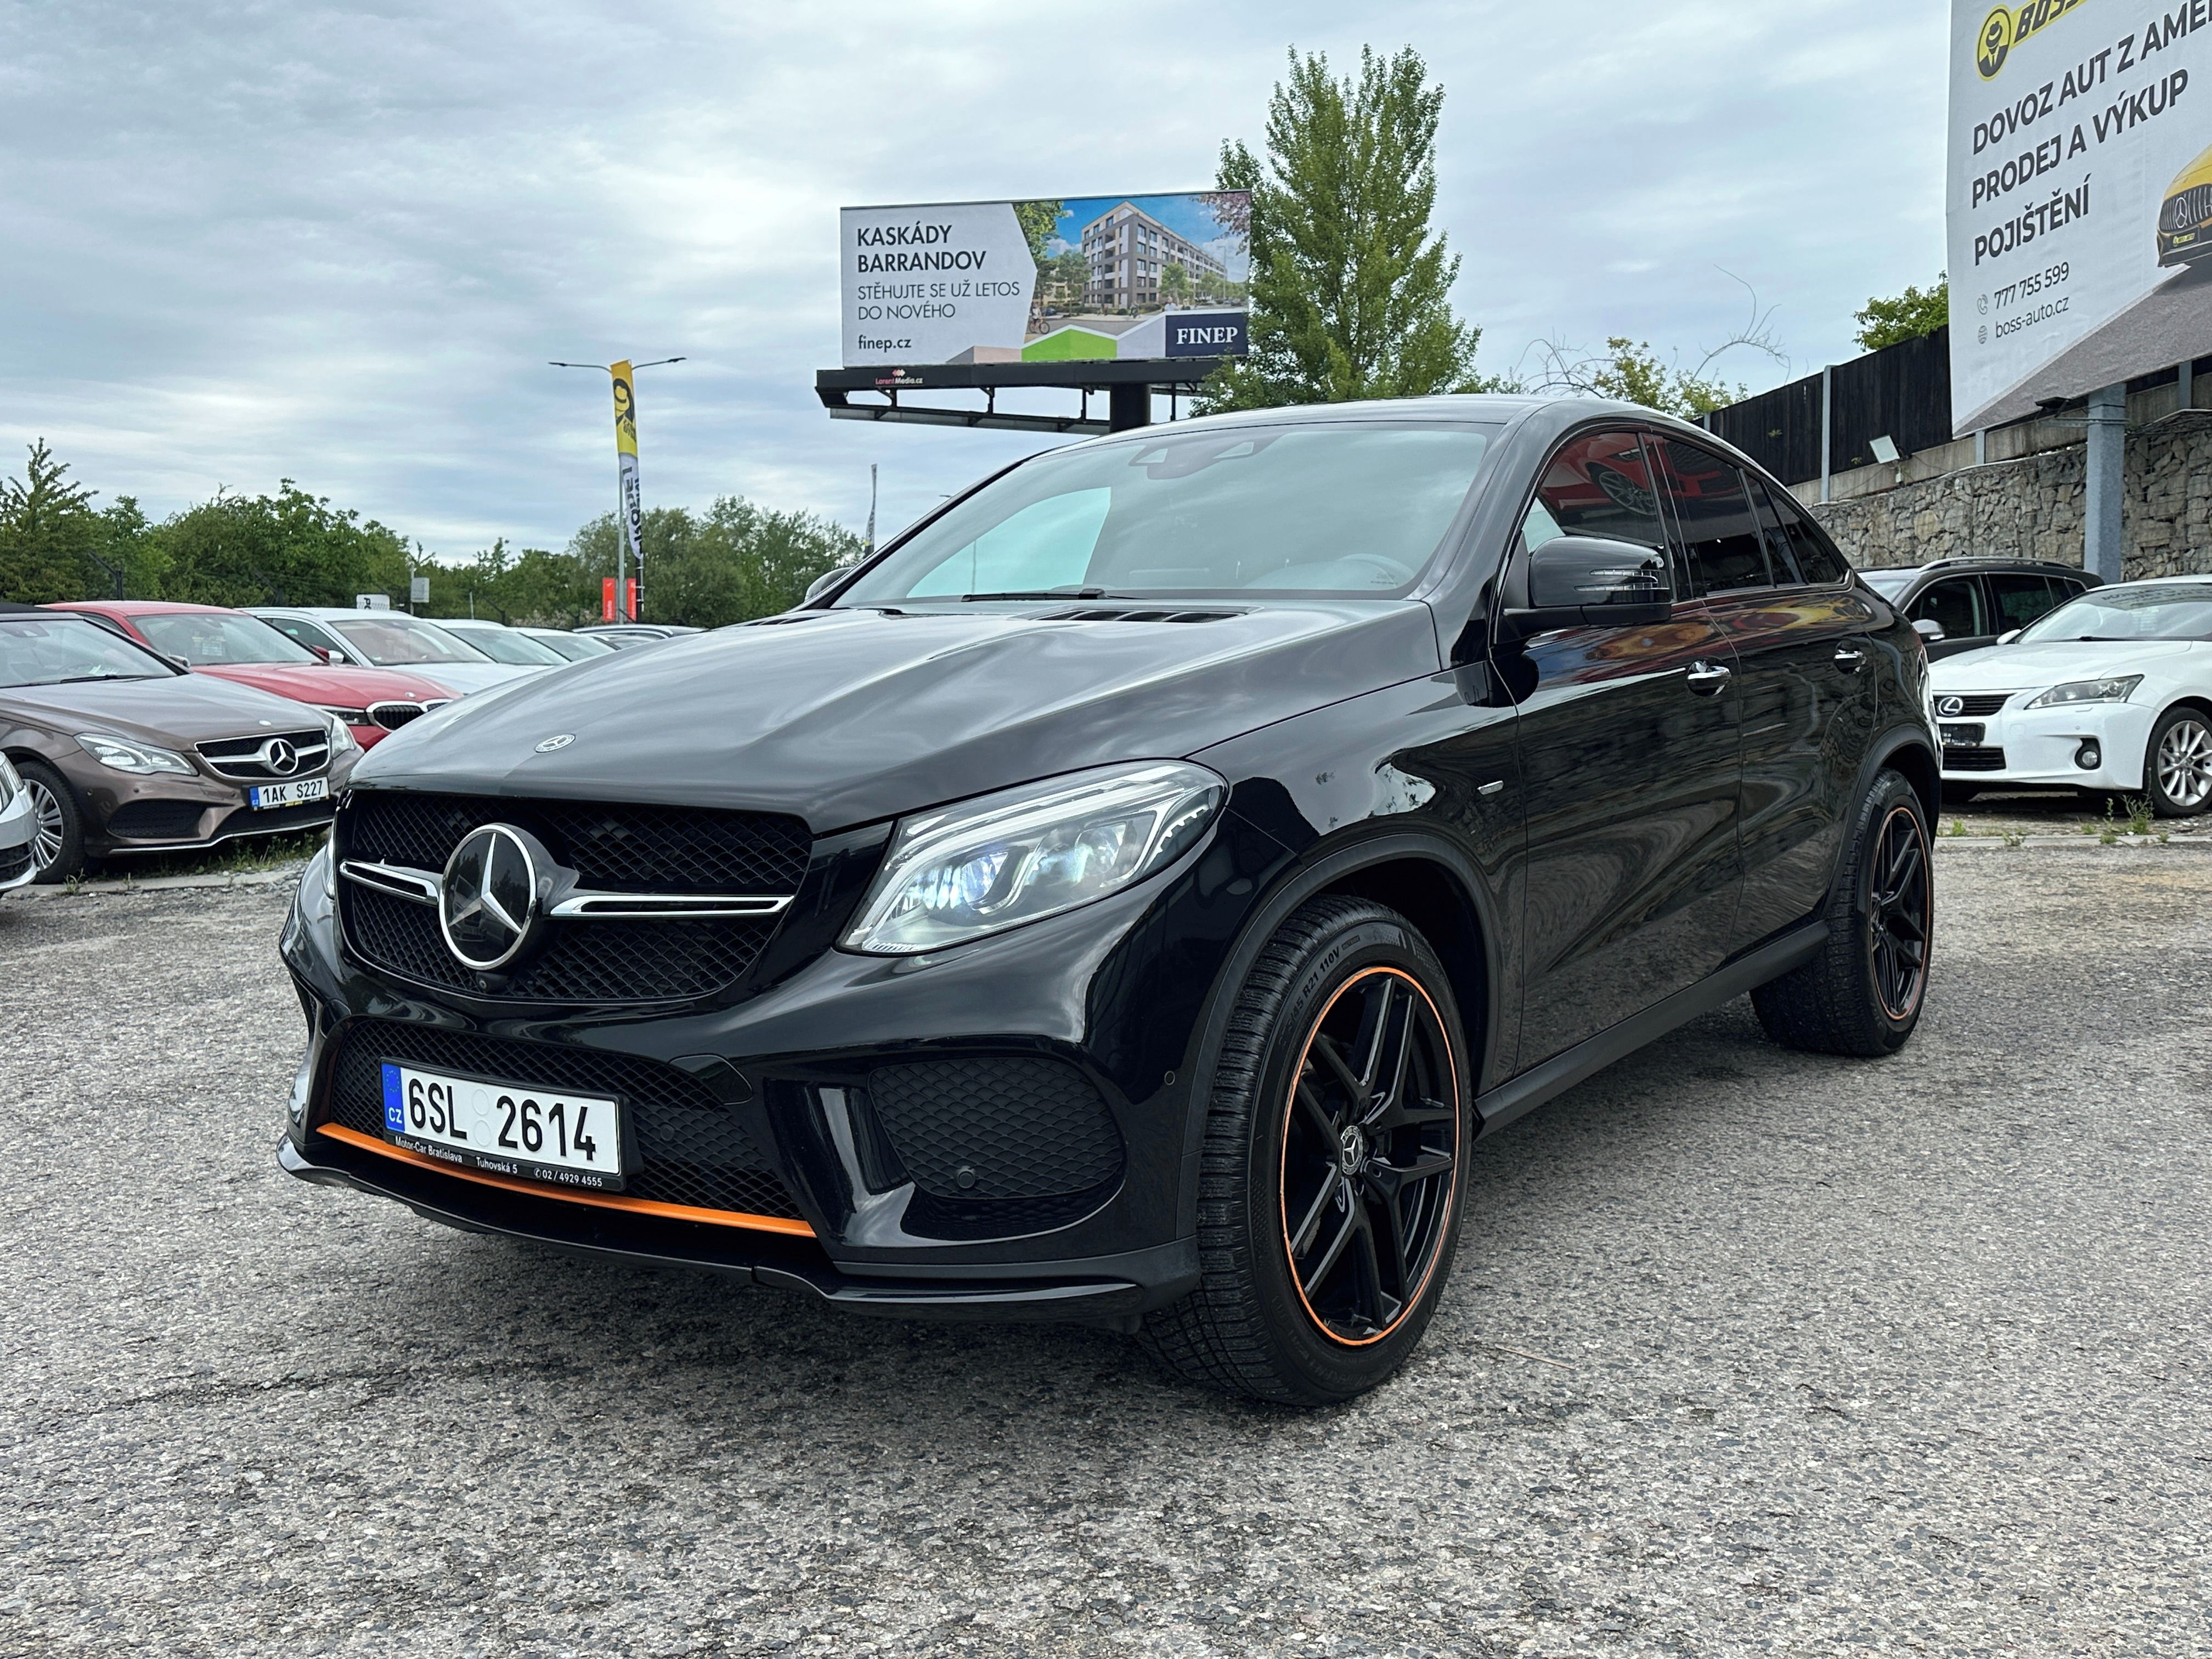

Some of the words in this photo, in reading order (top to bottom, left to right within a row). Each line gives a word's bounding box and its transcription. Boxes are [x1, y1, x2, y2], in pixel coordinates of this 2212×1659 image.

[1973, 81, 2053, 155] DOVOZ
[2058, 48, 2111, 107] AUT
[2117, 33, 2135, 74] Z
[2140, 0, 2212, 61] AME
[1972, 134, 2062, 209] PRODEJ
[2067, 124, 2087, 160] A
[2092, 69, 2188, 144] VÝKUP
[857, 221, 952, 246] KASKÁDY
[1975, 173, 2091, 266] POJIŠTĚNÍ
[857, 251, 986, 273] BARRANDOV
[858, 280, 925, 300] STĚHUJTE
[929, 283, 946, 298] SE
[951, 279, 971, 297] UŽ
[976, 281, 1020, 297] LETOS
[1994, 285, 2016, 309] 777
[2019, 273, 2041, 300] 755
[2045, 262, 2069, 287] 599
[858, 305, 882, 320] DO
[887, 301, 956, 319] NOVÉHO
[1995, 296, 2069, 338] boss-auto.cz
[857, 335, 912, 354] finep.cz
[1176, 325, 1238, 345] FINEP
[263, 786, 287, 803] 1AK
[296, 780, 323, 799] S227
[1302, 972, 1319, 999] R21
[1319, 946, 1340, 973] 110V
[388, 1107, 403, 1124] CZ
[408, 1077, 467, 1141] 6SL
[496, 1095, 596, 1162] 2614
[395, 1136, 427, 1154] Motor-Car
[428, 1144, 463, 1163] Bratislava
[476, 1157, 511, 1173] Tuhovská
[512, 1164, 518, 1174] 5
[542, 1170, 552, 1180] 02
[560, 1172, 579, 1184] 4929
[582, 1175, 602, 1187] 4555
